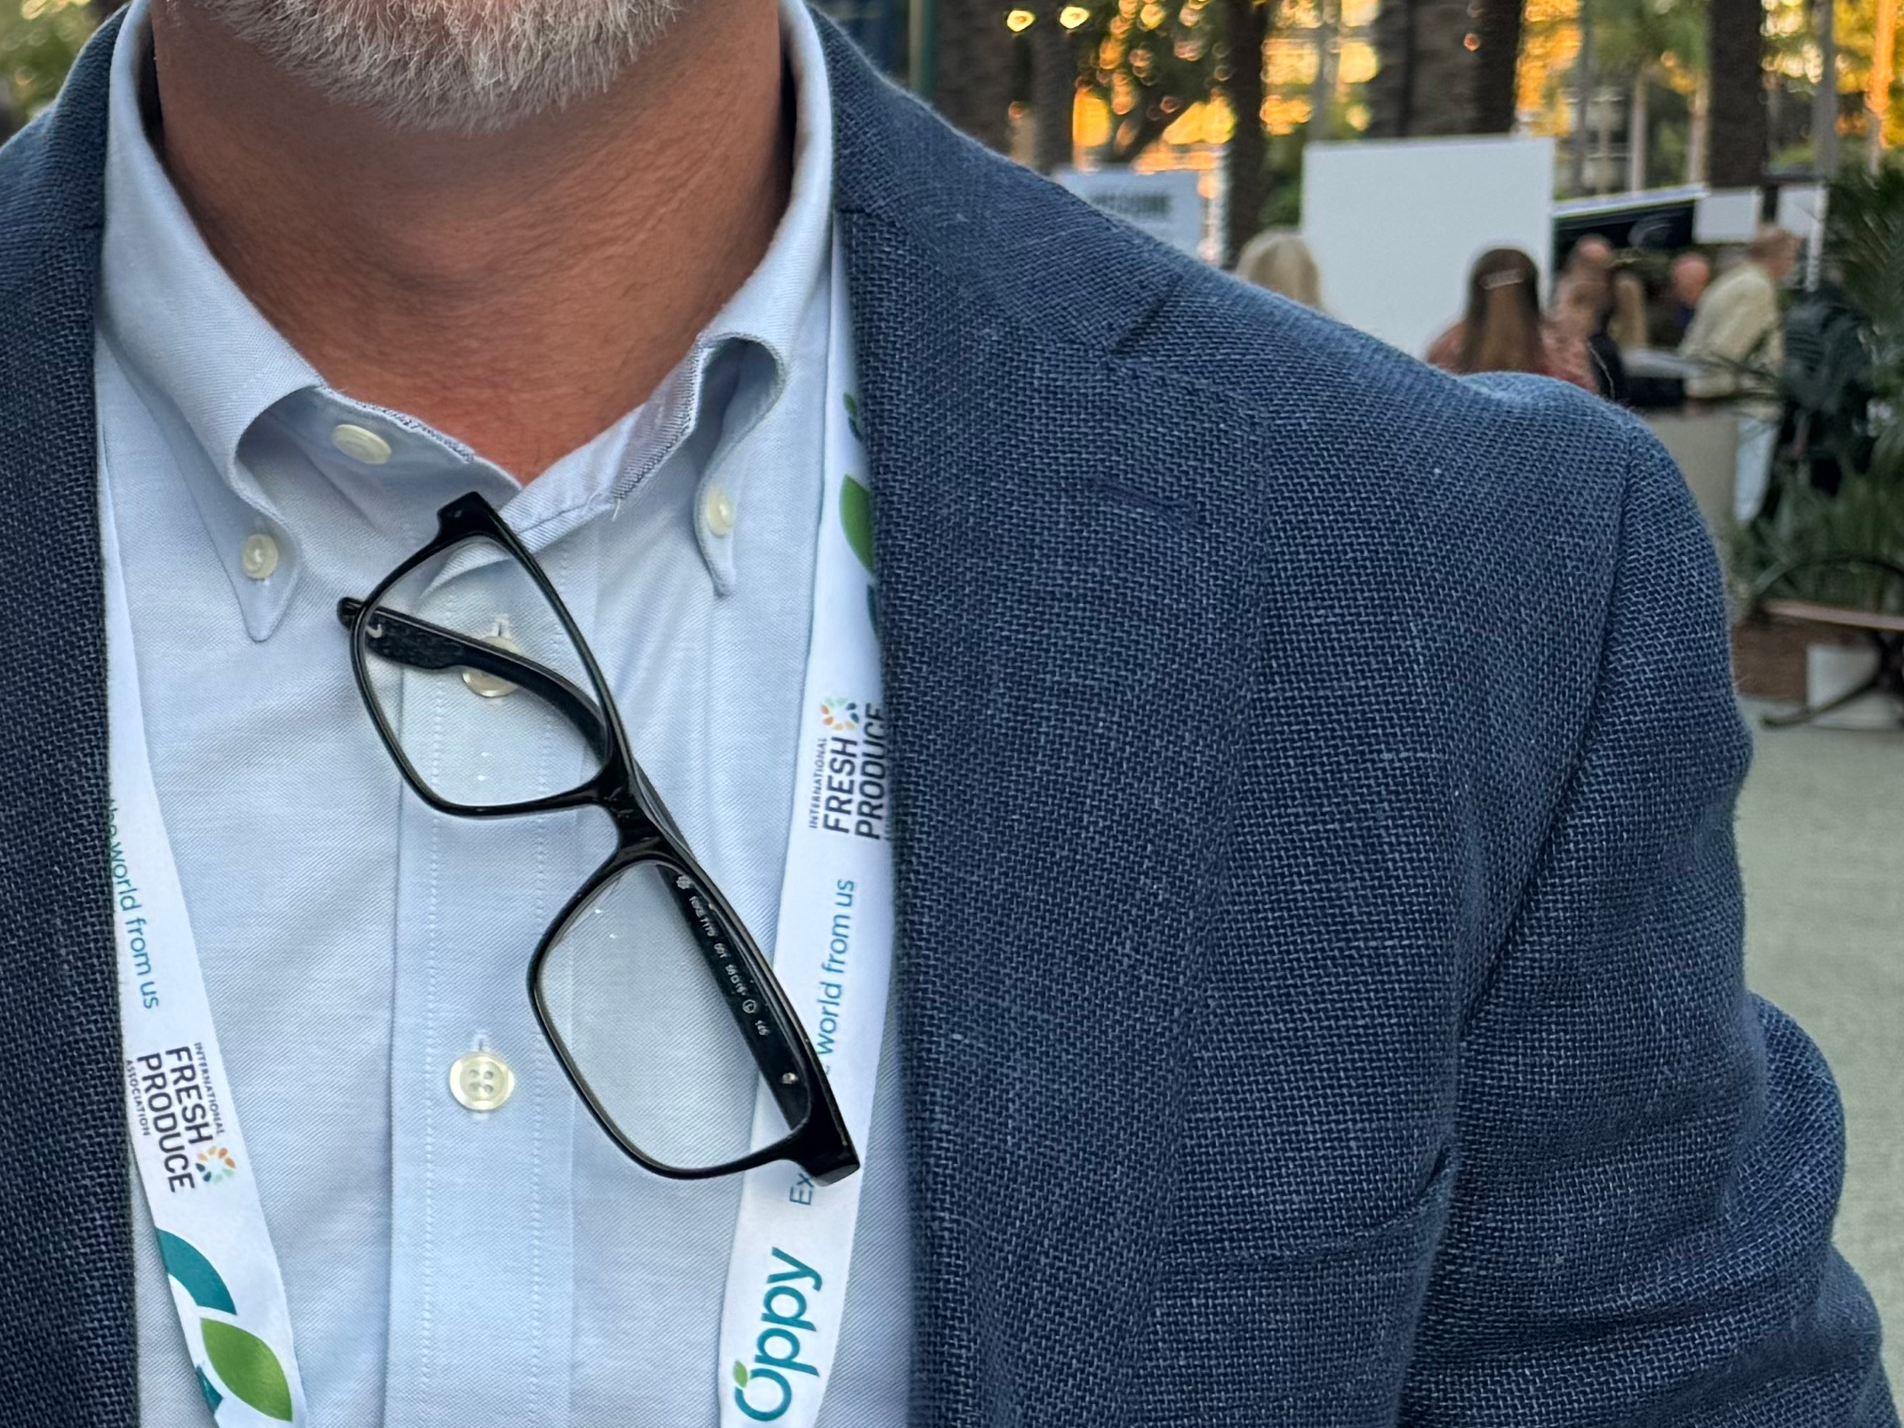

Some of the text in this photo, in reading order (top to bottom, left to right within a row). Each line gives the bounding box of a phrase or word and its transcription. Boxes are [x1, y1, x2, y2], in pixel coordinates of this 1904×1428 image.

[823, 736, 859, 834] FRESH
[854, 703, 886, 841] PRODUCE
[111, 841, 142, 911] world
[126, 916, 153, 977] from
[140, 980, 159, 1010] us
[817, 879, 854, 1055] world from us
[126, 1060, 151, 1137] ASSOCIATION
[137, 1052, 196, 1194] PRODUCE
[166, 1045, 214, 1146] FRESH
[193, 1042, 225, 1136] INTERNATIONAL
[733, 1246, 823, 1424] Oppy
